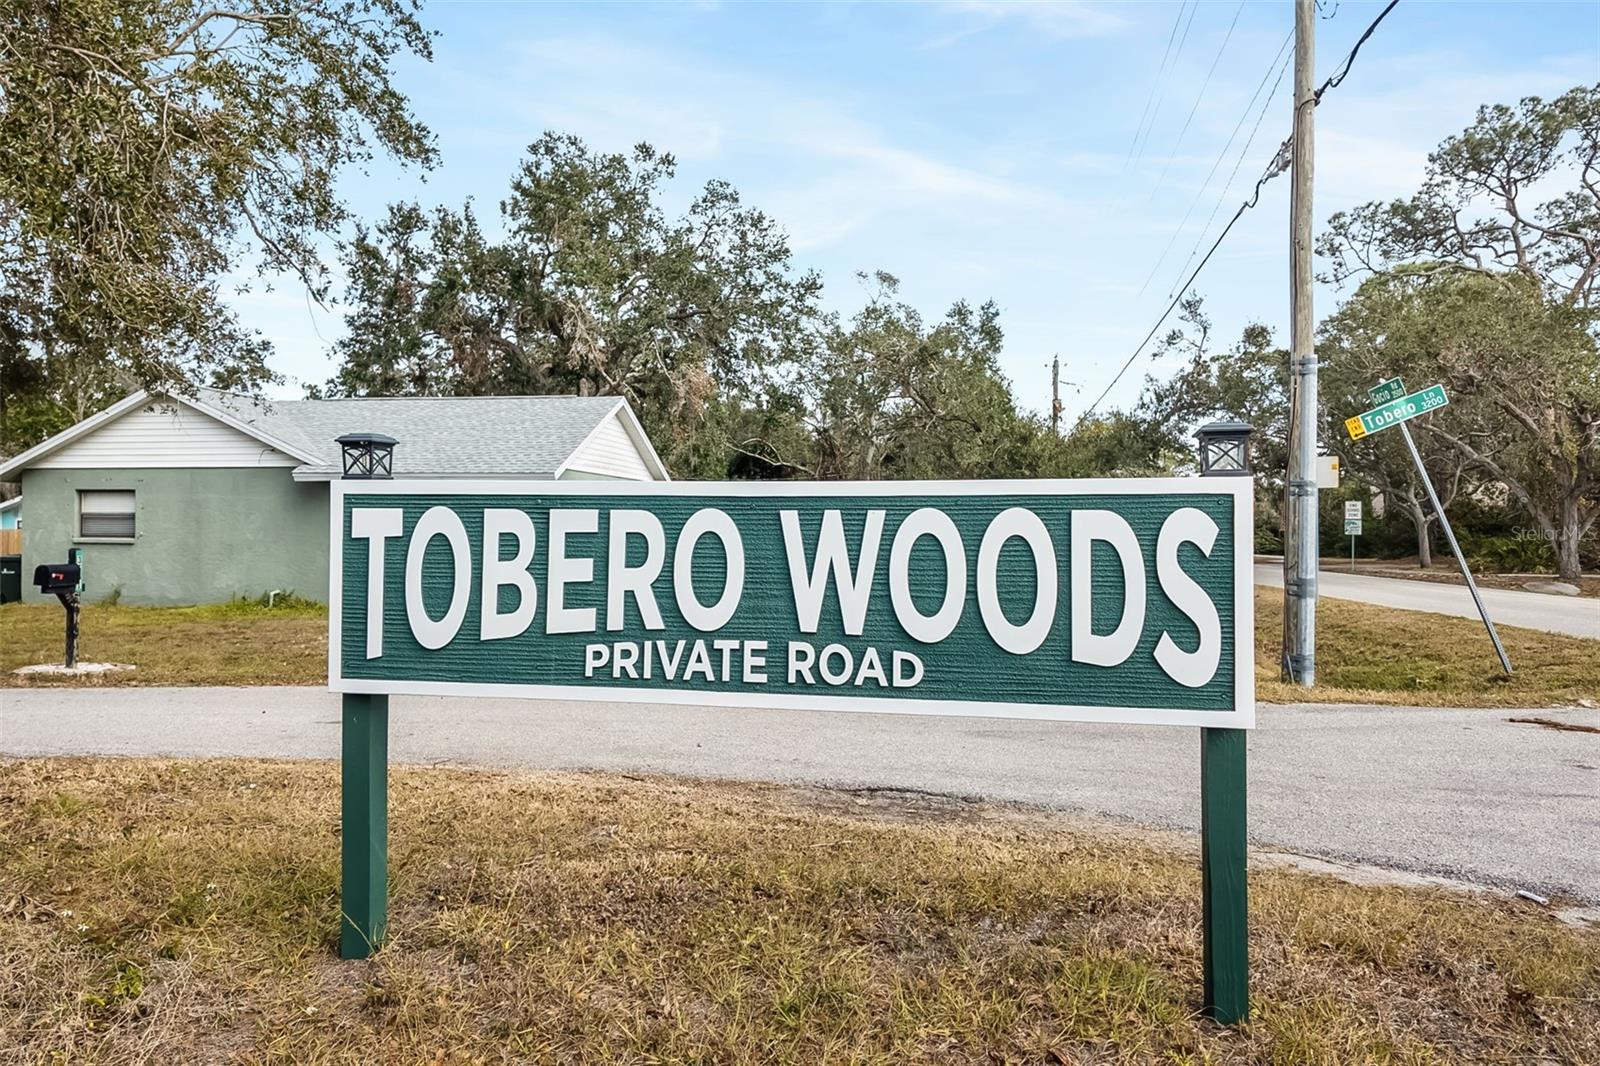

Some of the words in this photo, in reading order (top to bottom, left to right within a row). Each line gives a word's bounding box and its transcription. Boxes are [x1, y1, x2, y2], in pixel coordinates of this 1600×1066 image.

[1421, 396, 1443, 411] 3200
[1423, 391, 1435, 401] Ln
[1365, 402, 1416, 429] Tobero
[351, 506, 745, 661] TOBERO
[779, 507, 1222, 688] WOODS
[585, 639, 768, 684] PRIVATE
[787, 641, 925, 688] ROAD
